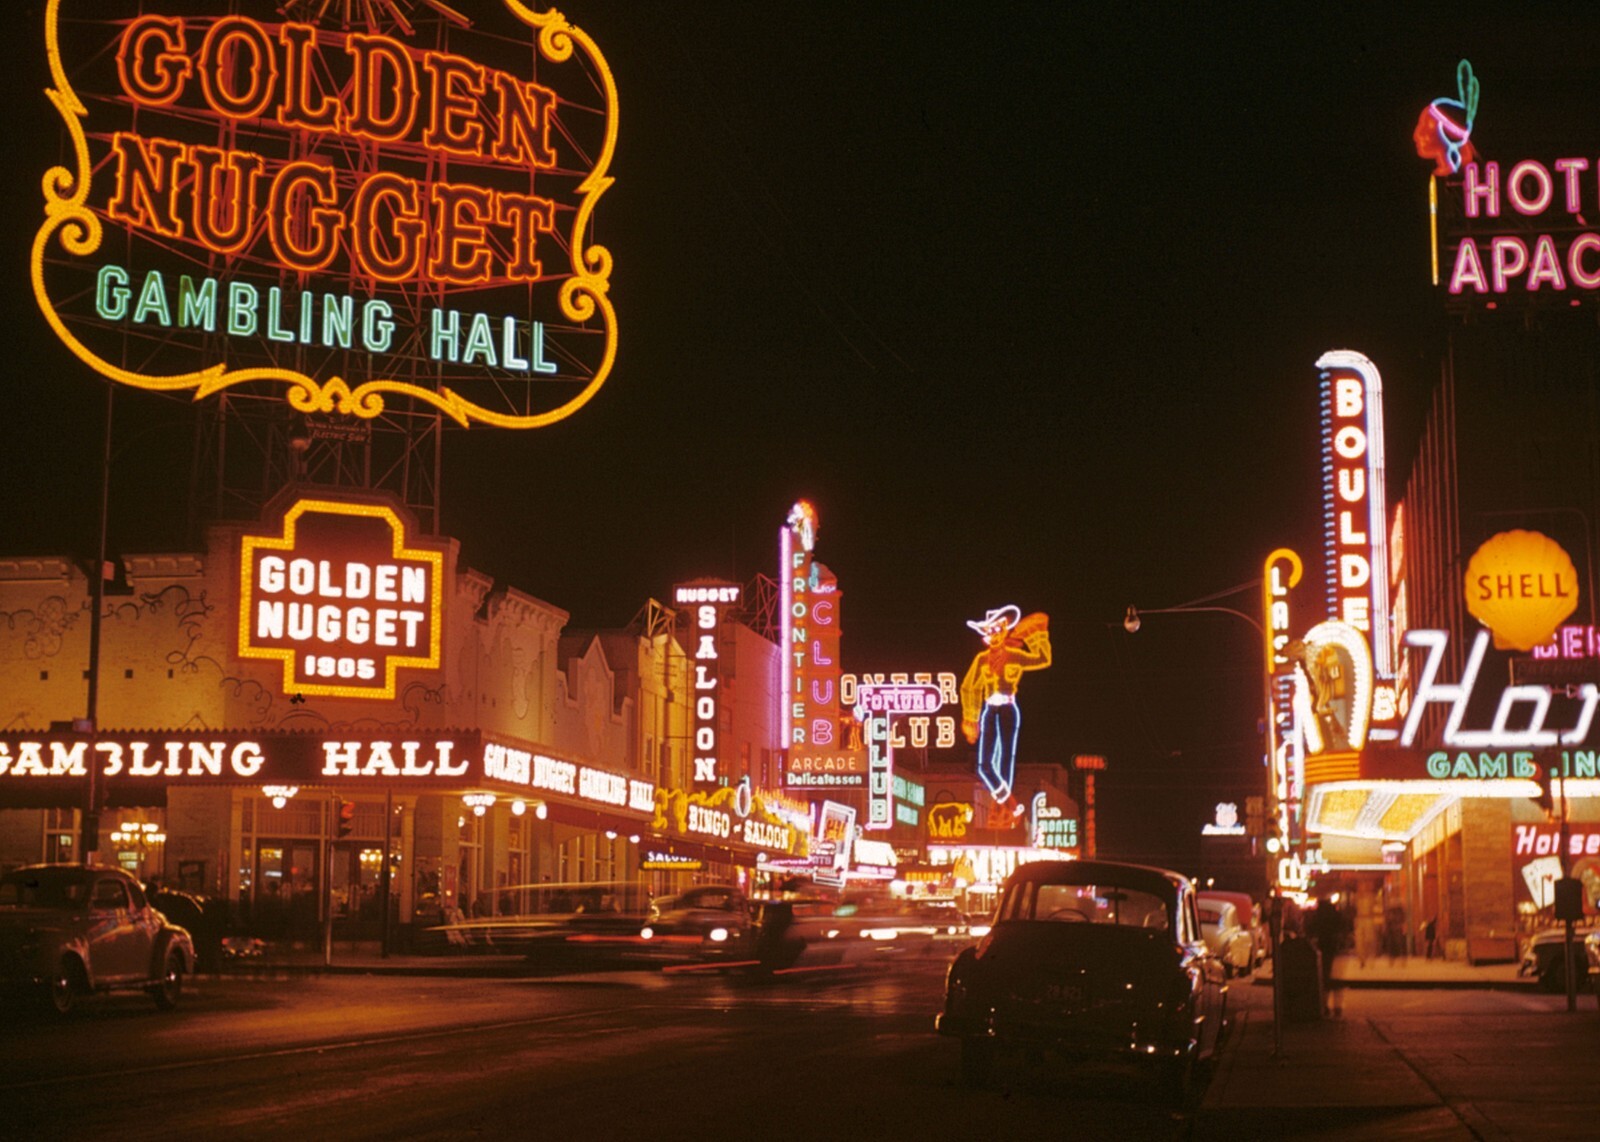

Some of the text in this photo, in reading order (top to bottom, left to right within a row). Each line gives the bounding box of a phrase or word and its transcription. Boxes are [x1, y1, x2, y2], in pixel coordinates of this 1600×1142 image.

[116, 14, 556, 168] GOLDEN
[109, 132, 554, 284] NUGGET
[1465, 158, 1600, 216] HOT
[1448, 234, 1600, 293] APAC
[96, 265, 557, 374] GAMBLING HALL
[258, 556, 425, 603] GOLDEN
[676, 587, 739, 603] NUGGET
[1477, 573, 1569, 600] SHELL
[257, 602, 424, 647] NUGGET
[792, 553, 806, 743] FRONTIER
[304, 655, 376, 681] 1905
[694, 605, 717, 782] SALOON
[811, 602, 833, 744] CLUB
[322, 742, 468, 776] HALL
[787, 772, 862, 786] Delicatessen
[791, 757, 857, 770] ARCADE
[872, 717, 888, 822] CLUB
[688, 805, 730, 838] BINGO
[743, 820, 789, 850] SALOON
